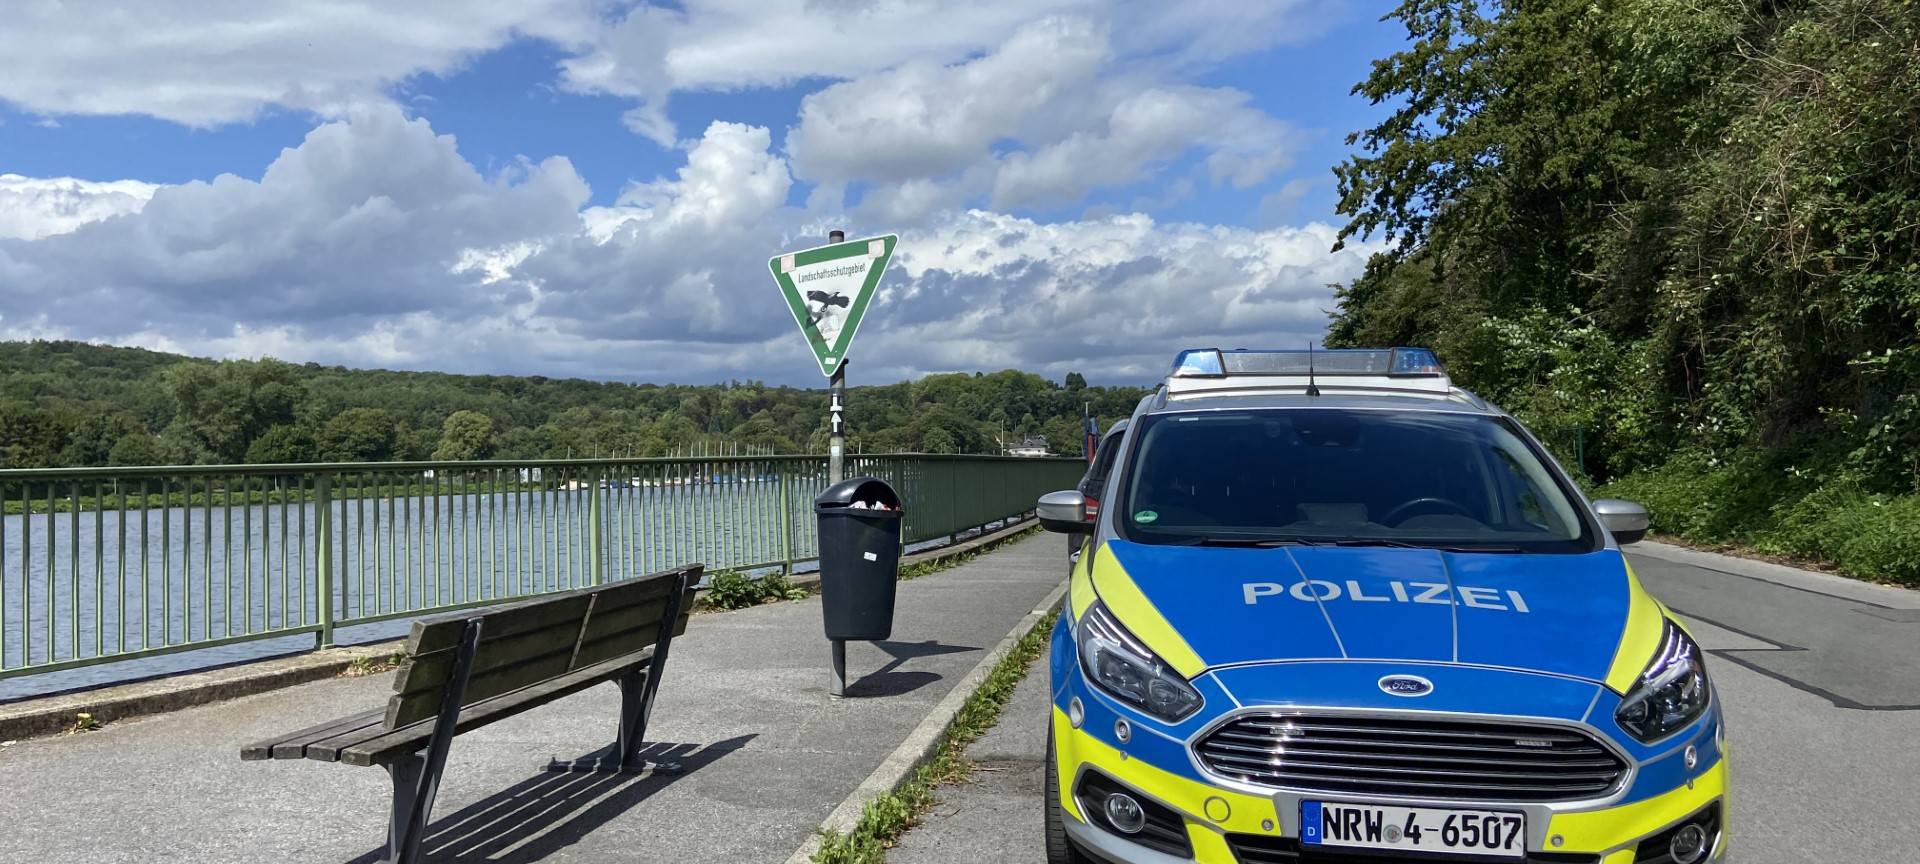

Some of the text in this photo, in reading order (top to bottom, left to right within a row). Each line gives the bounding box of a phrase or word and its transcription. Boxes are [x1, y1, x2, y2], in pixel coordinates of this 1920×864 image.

[798, 263, 866, 284] Landschaftsschutzgebiet
[1242, 579, 1530, 613] POLIZEI
[1307, 826, 1316, 837] D
[1321, 806, 1522, 850] NRW 4-6507
